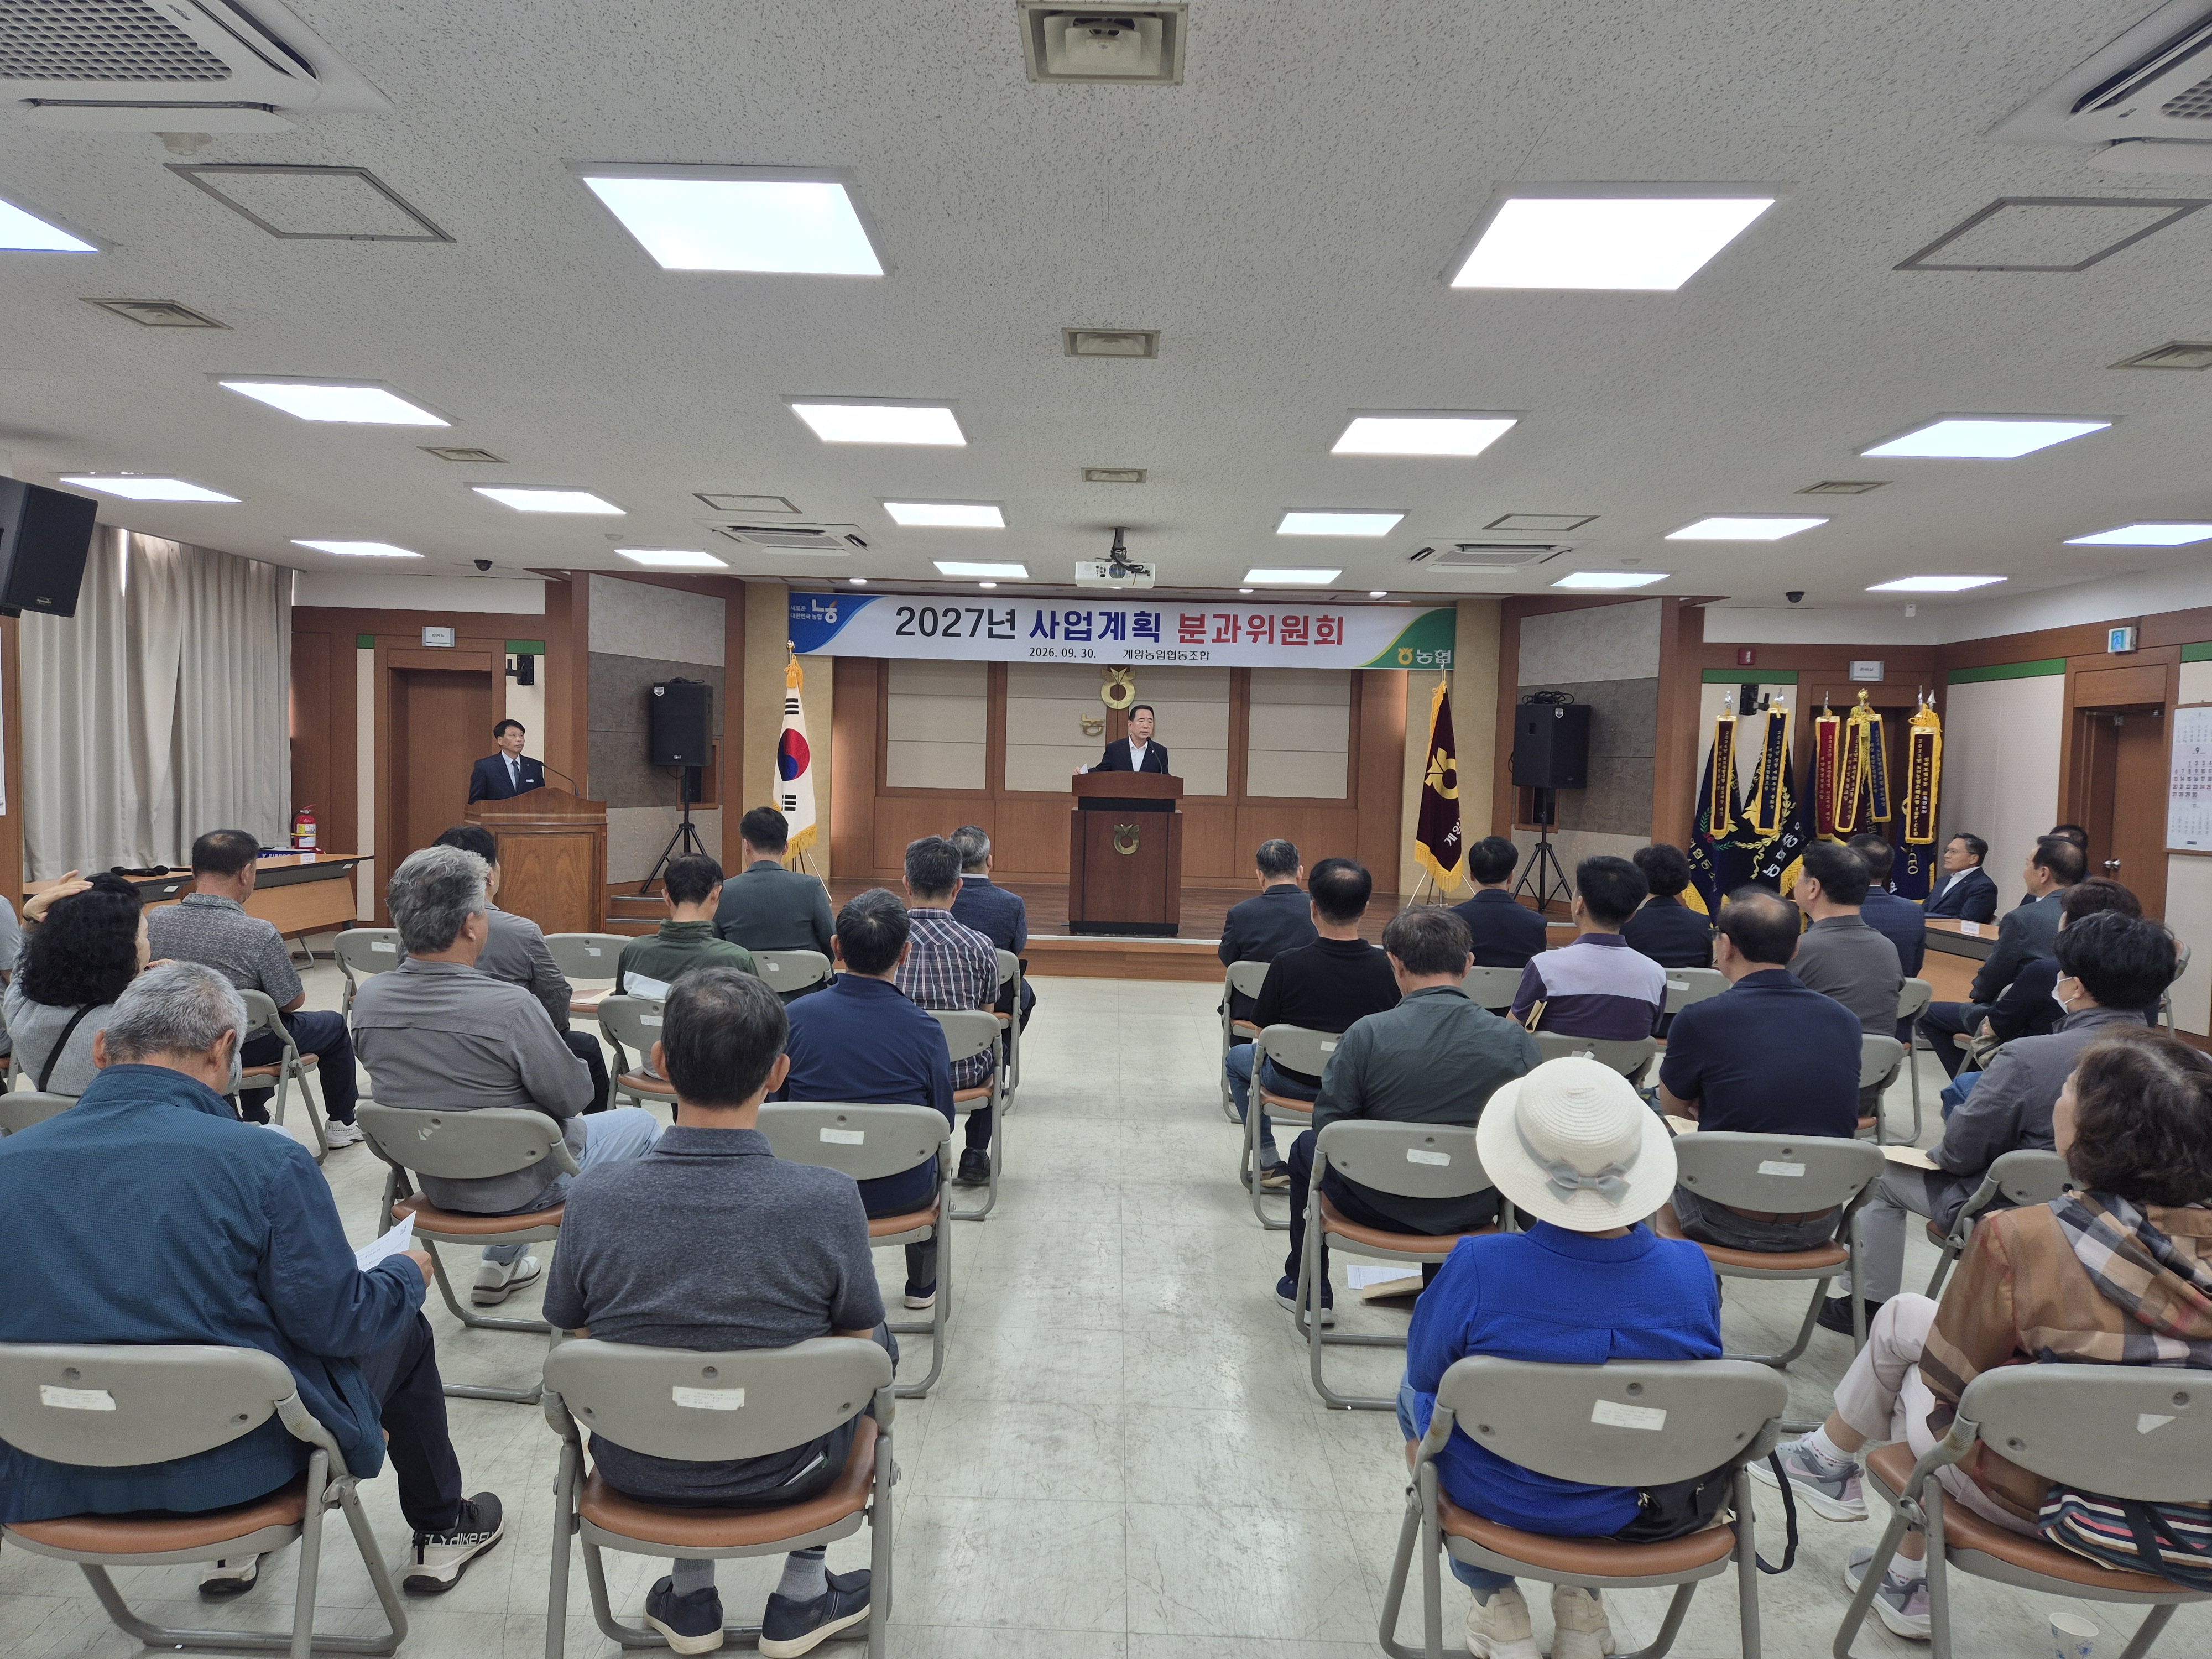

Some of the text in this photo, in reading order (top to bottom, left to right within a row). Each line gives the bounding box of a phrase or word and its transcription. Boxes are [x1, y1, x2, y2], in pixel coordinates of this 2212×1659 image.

[896, 606, 1344, 647] 2027년 사업계획 분과위원회
[1029, 647, 1096, 659] 2026. 09. 30.
[1123, 649, 1210, 661] 계양농업협동조합
[1416, 649, 1451, 664] 농협
